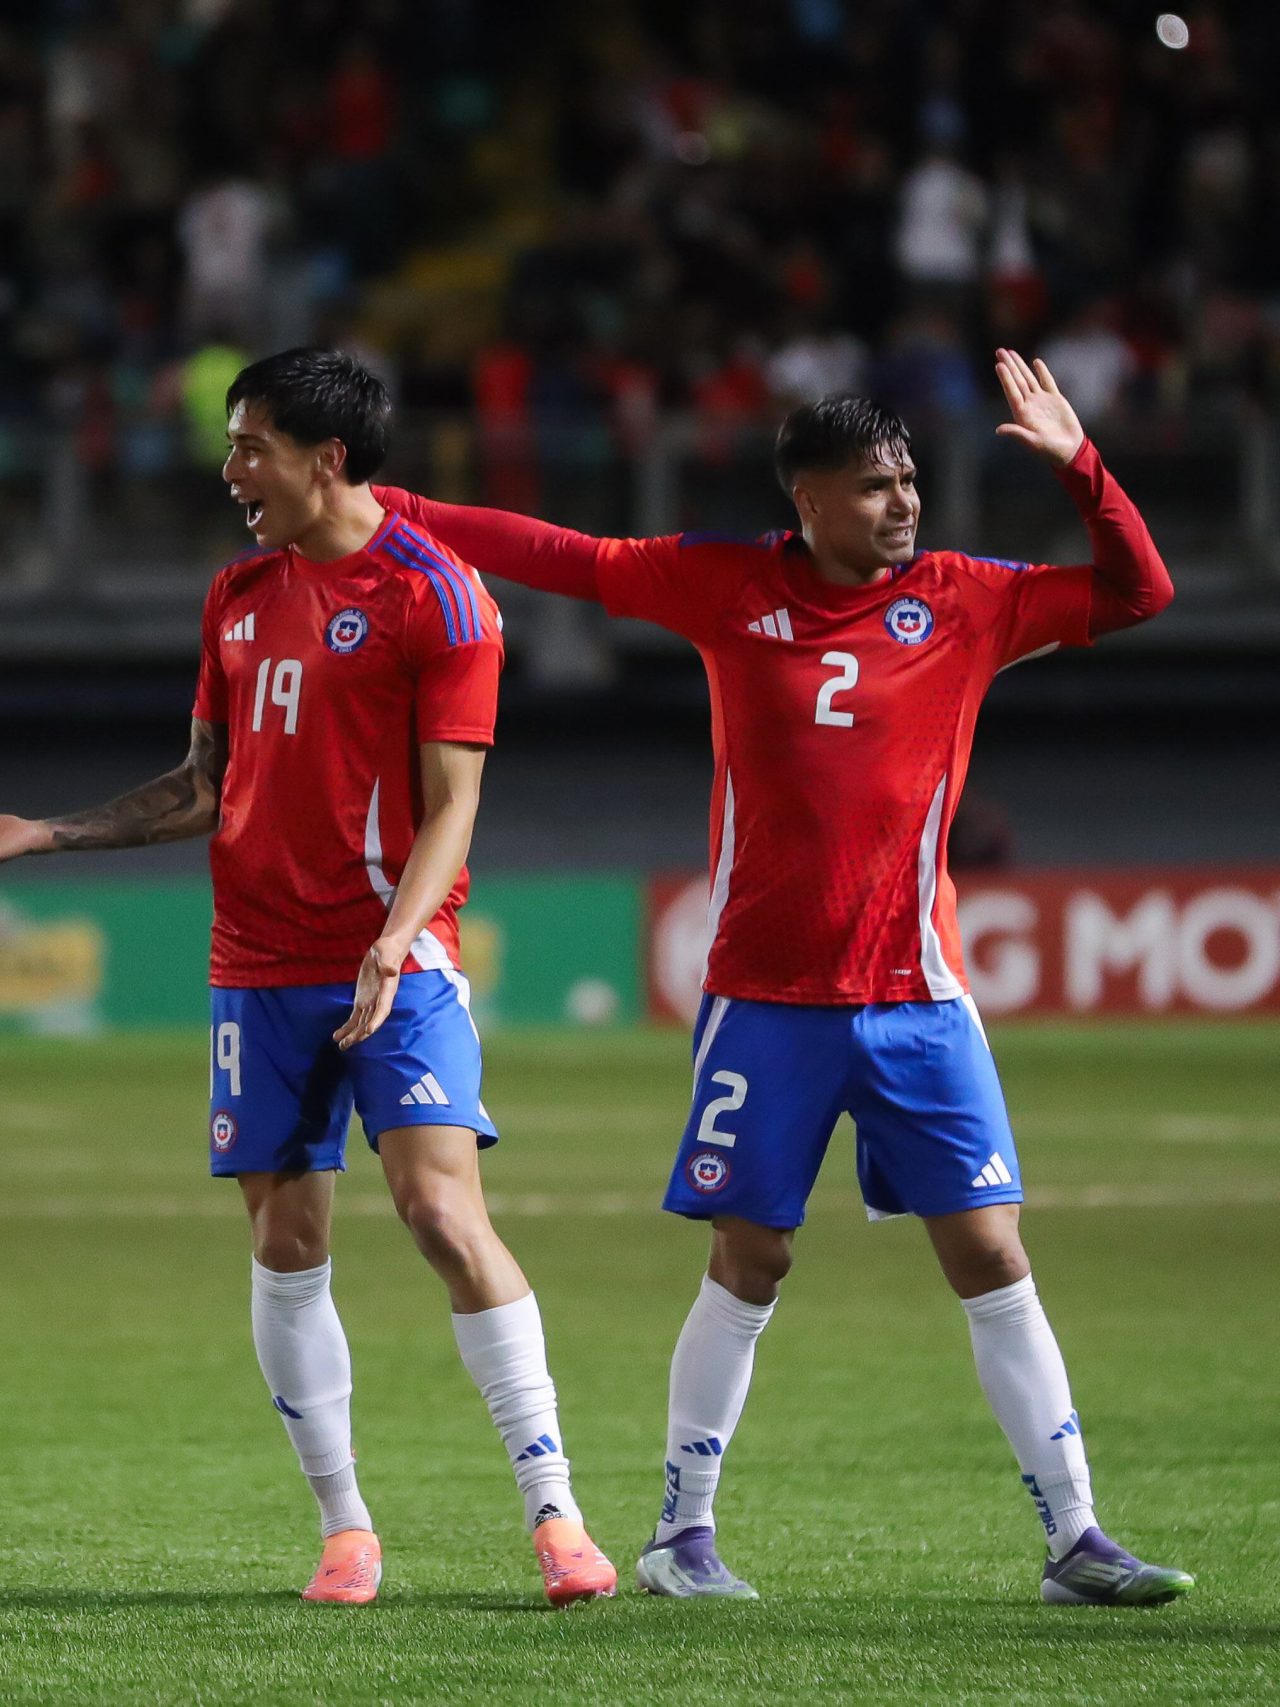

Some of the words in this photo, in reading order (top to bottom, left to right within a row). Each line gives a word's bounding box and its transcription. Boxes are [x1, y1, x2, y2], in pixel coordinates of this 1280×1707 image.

[252, 658, 303, 734] 19
[815, 651, 859, 728] 2
[1065, 888, 1280, 1013] MO
[696, 1070, 748, 1147] 2
